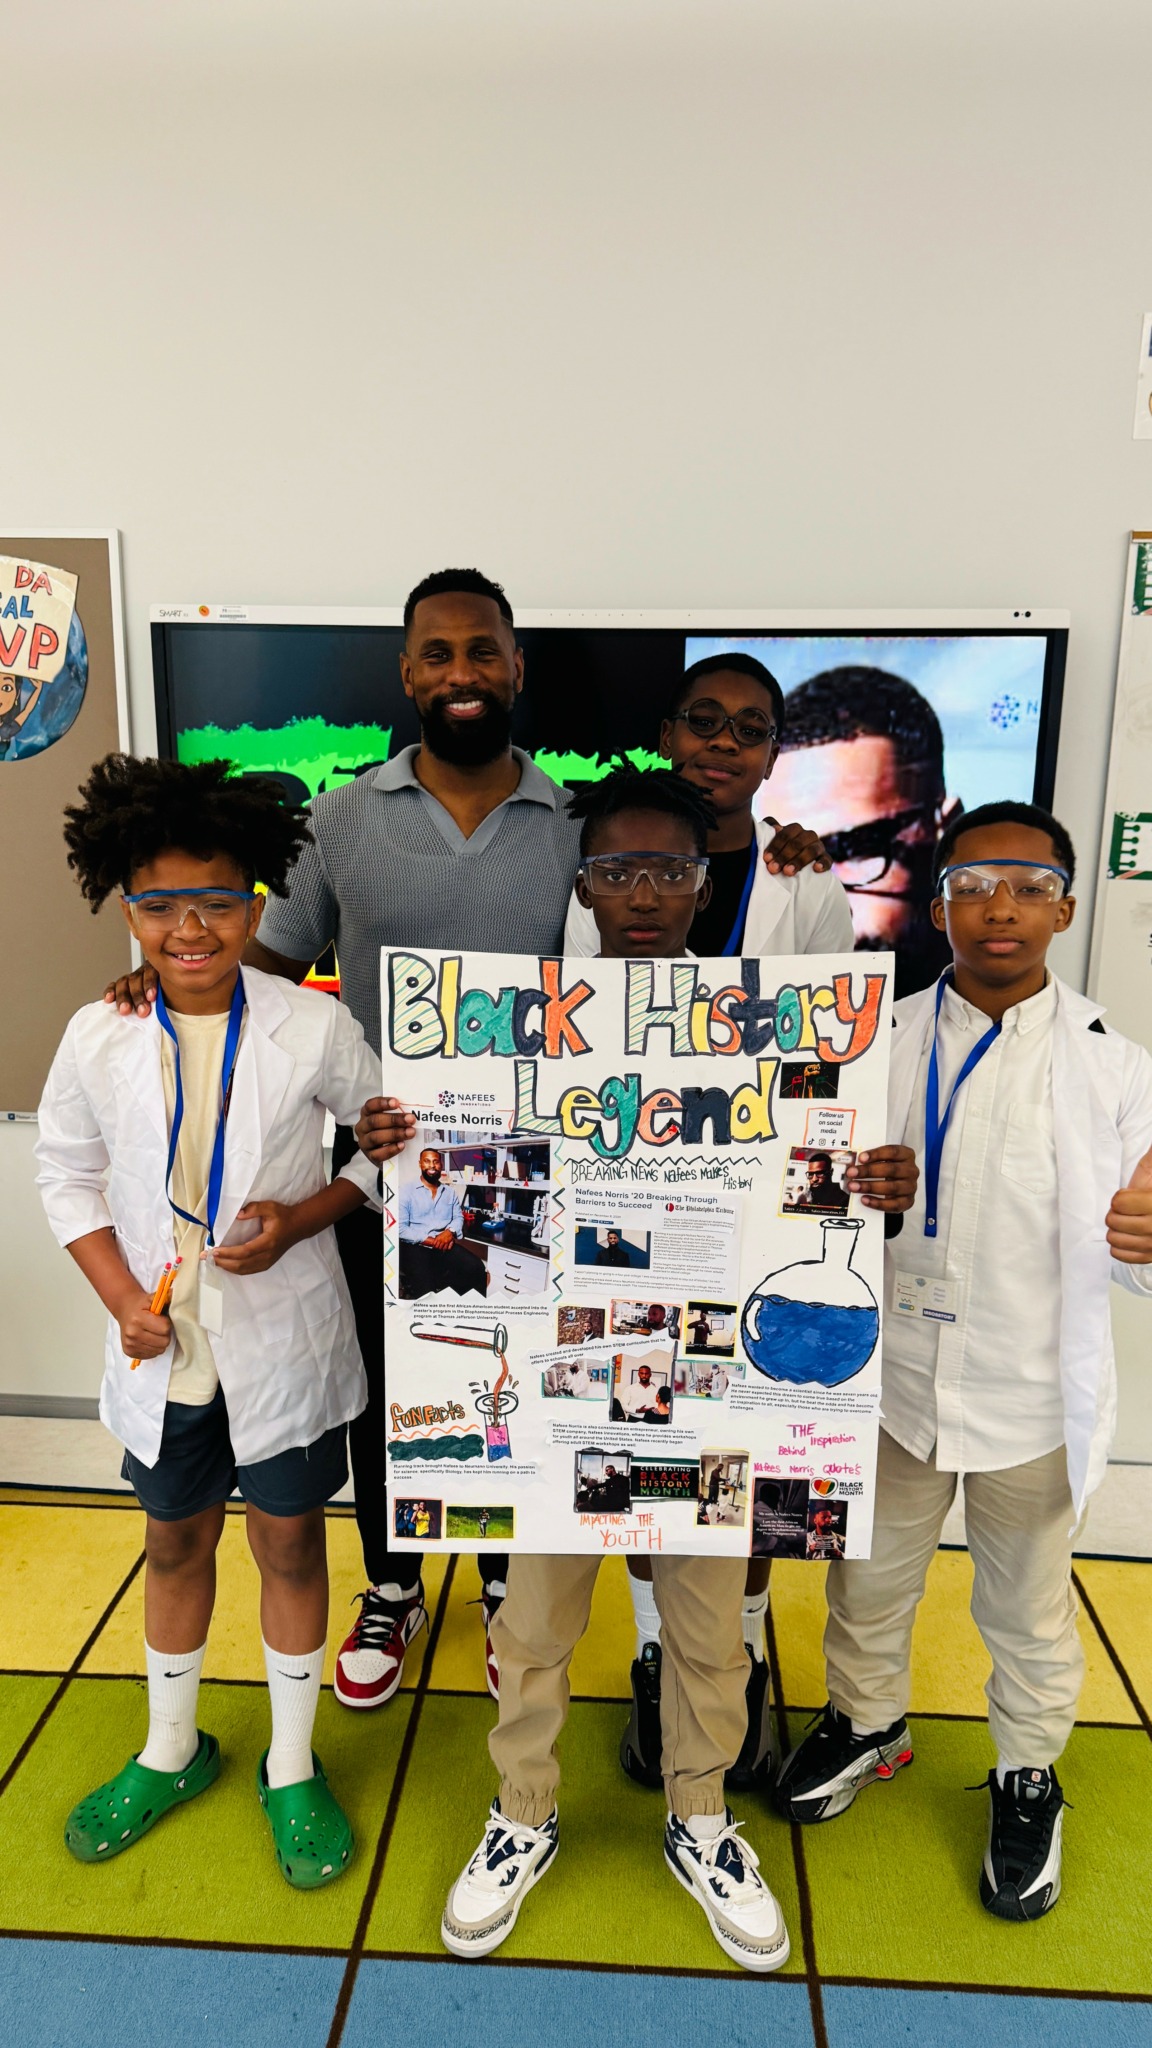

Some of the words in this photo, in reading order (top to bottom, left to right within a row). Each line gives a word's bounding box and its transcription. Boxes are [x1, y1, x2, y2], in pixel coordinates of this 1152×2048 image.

[15, 566, 52, 596] DA
[0, 592, 34, 619] AL
[159, 609, 182, 617] SMART
[388, 951, 596, 1059] Black
[624, 958, 887, 1064] History
[457, 1094, 496, 1102] NAFEES
[511, 1057, 781, 1159] Legend
[411, 1110, 457, 1124] Nafees
[461, 1113, 503, 1126] Norris
[571, 1160, 628, 1184] BREAKING
[664, 1167, 697, 1183] Nafees
[575, 1188, 603, 1197] Nafees
[605, 1190, 629, 1199] Norris
[631, 1192, 644, 1200] '20
[646, 1193, 682, 1203] Breaking
[684, 1195, 718, 1205] Through
[575, 1197, 606, 1207] Barriers
[618, 1201, 653, 1209] Succeed
[786, 1423, 817, 1438] THE
[778, 1445, 806, 1456] Behind
[640, 1471, 690, 1480] BLACK
[754, 1462, 781, 1473] Nafees
[789, 1465, 815, 1476] Norris
[640, 1480, 690, 1488] HISTORY
[640, 1487, 691, 1496] MONTH
[636, 1513, 655, 1527] THE
